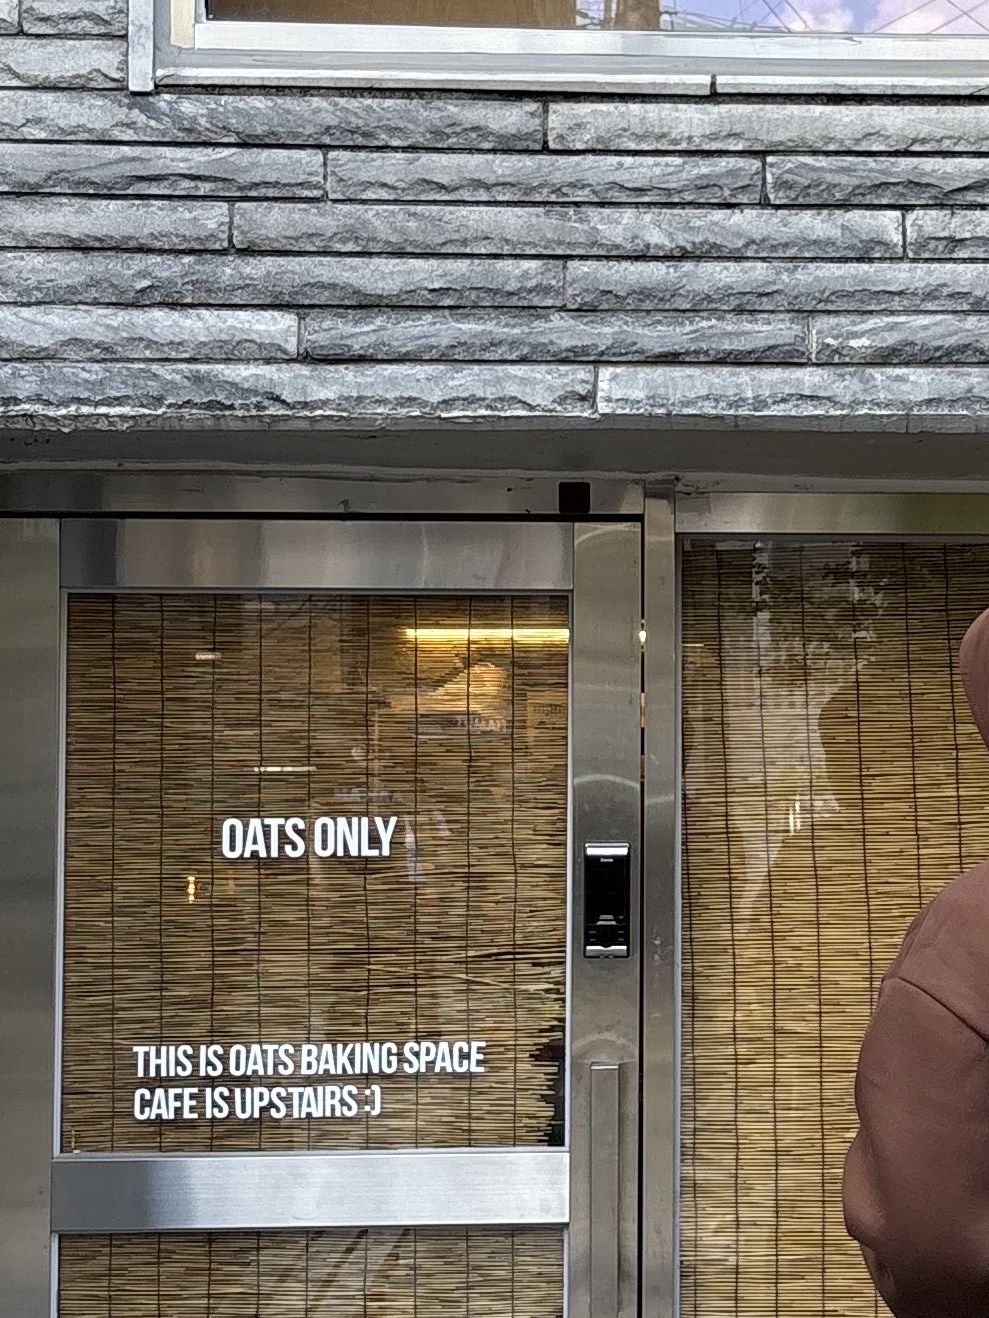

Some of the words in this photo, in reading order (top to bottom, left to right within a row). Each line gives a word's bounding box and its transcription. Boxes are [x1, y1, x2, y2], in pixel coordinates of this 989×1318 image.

[222, 817, 306, 859] OATS
[314, 816, 398, 857] ONLY
[133, 1045, 193, 1077] THIS
[199, 1044, 224, 1077] IS
[229, 1043, 295, 1076] OATS
[300, 1042, 398, 1075] BAKING
[403, 1041, 486, 1073] SPACE
[133, 1087, 198, 1120] CAFE
[206, 1087, 229, 1119] IS
[235, 1085, 358, 1119] UPSTAIRS
